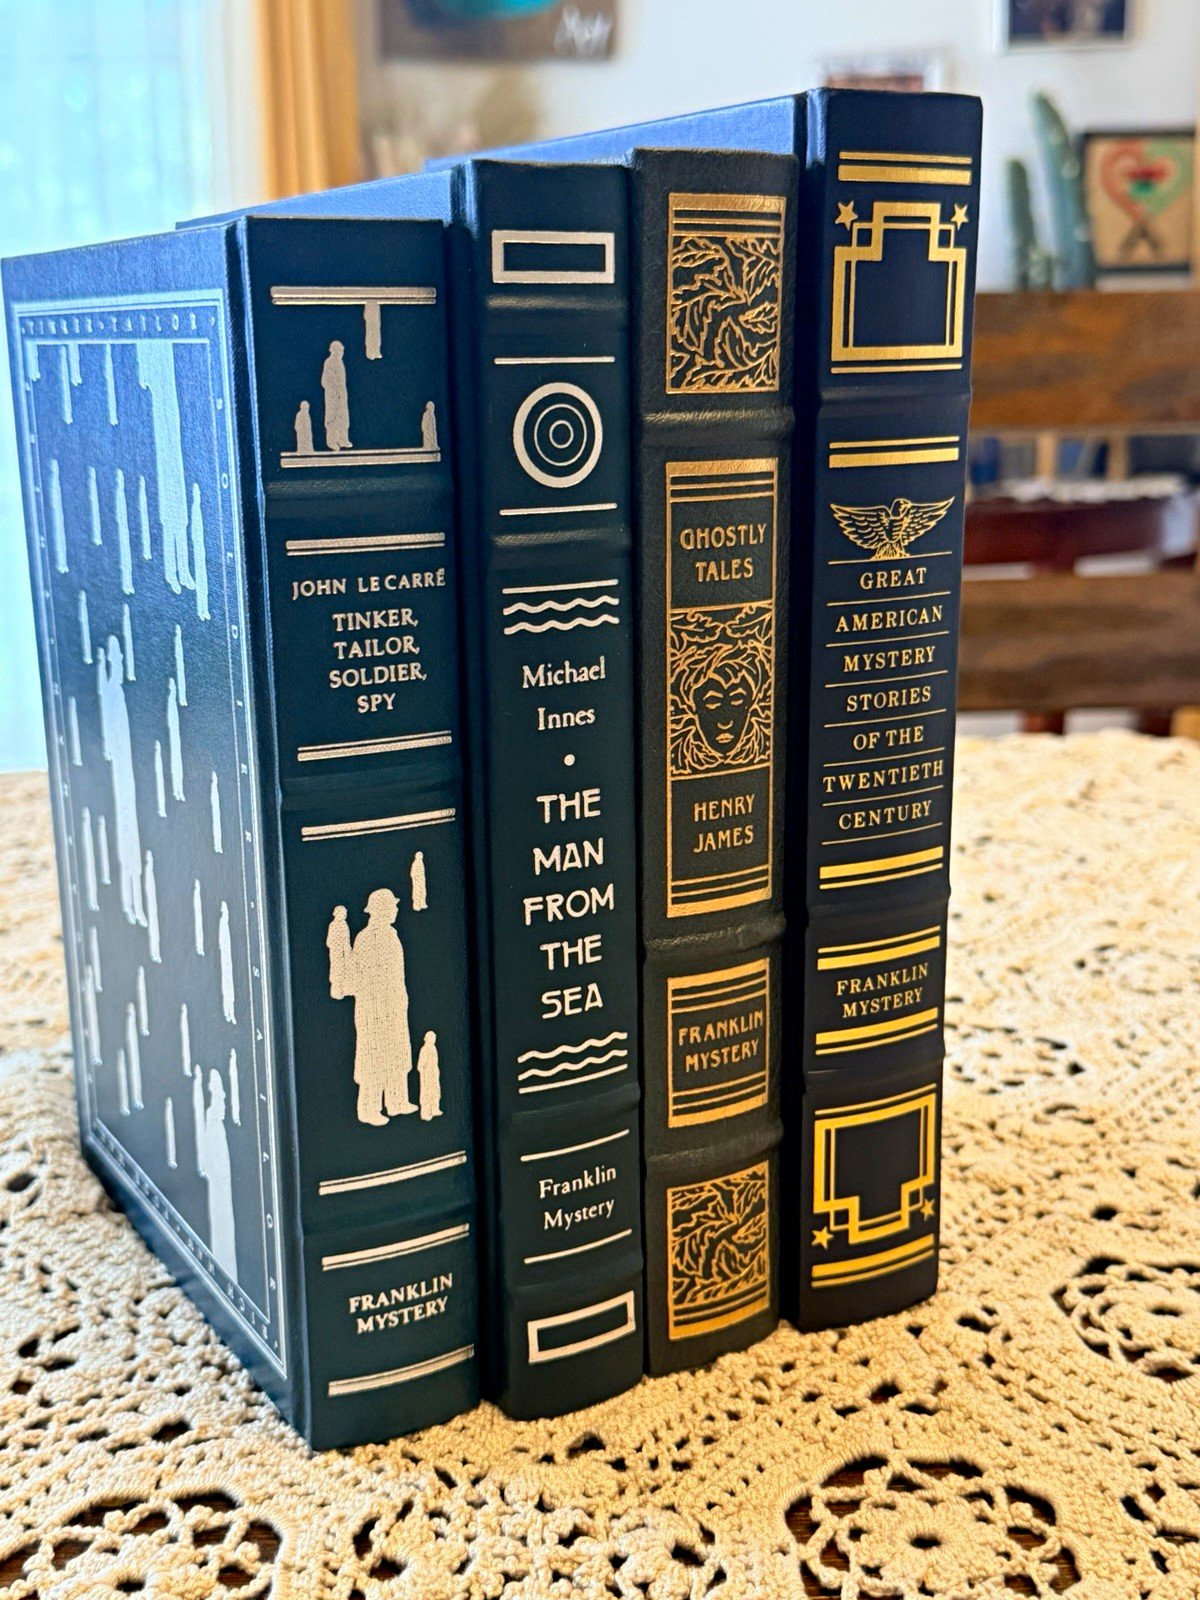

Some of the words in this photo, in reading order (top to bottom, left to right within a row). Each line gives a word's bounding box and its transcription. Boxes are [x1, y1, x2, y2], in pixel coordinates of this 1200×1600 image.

[679, 523, 768, 551] GHOSTLY
[292, 578, 346, 601] JOHN
[358, 576, 380, 593] LE
[384, 568, 446, 590] CARRÉ
[695, 557, 754, 584] TALES
[859, 567, 928, 591] GREAT
[332, 608, 419, 632] TINKER,
[835, 604, 944, 634] AMERICAN
[333, 635, 420, 660] TAILOR,
[843, 645, 936, 673] MYSTERY
[329, 662, 427, 688] SOLDIER,
[522, 655, 606, 689] Michael
[357, 693, 396, 714] SPY
[846, 685, 932, 714] STORIES
[537, 706, 596, 731] Innes
[852, 731, 881, 752] OF
[885, 725, 924, 748] THE
[823, 759, 944, 794] TWENTIETH
[536, 788, 601, 824] THE
[693, 793, 756, 823] HENRY
[838, 799, 932, 831] CENTURY
[693, 824, 754, 853] JAMES
[533, 837, 604, 876] MAN
[523, 883, 615, 926] FROM
[539, 933, 603, 971] THE
[836, 962, 929, 996] FRANKLIN
[541, 982, 603, 1020] SEA
[842, 987, 924, 1019] MYSTERY
[678, 1008, 764, 1047] FRANKLIN
[685, 1038, 759, 1073] MYSTERY
[539, 1165, 617, 1199] Franklin
[543, 1199, 615, 1231] Mystery
[349, 1272, 453, 1314] FRANKLIN
[356, 1296, 448, 1335] MYSTERY
